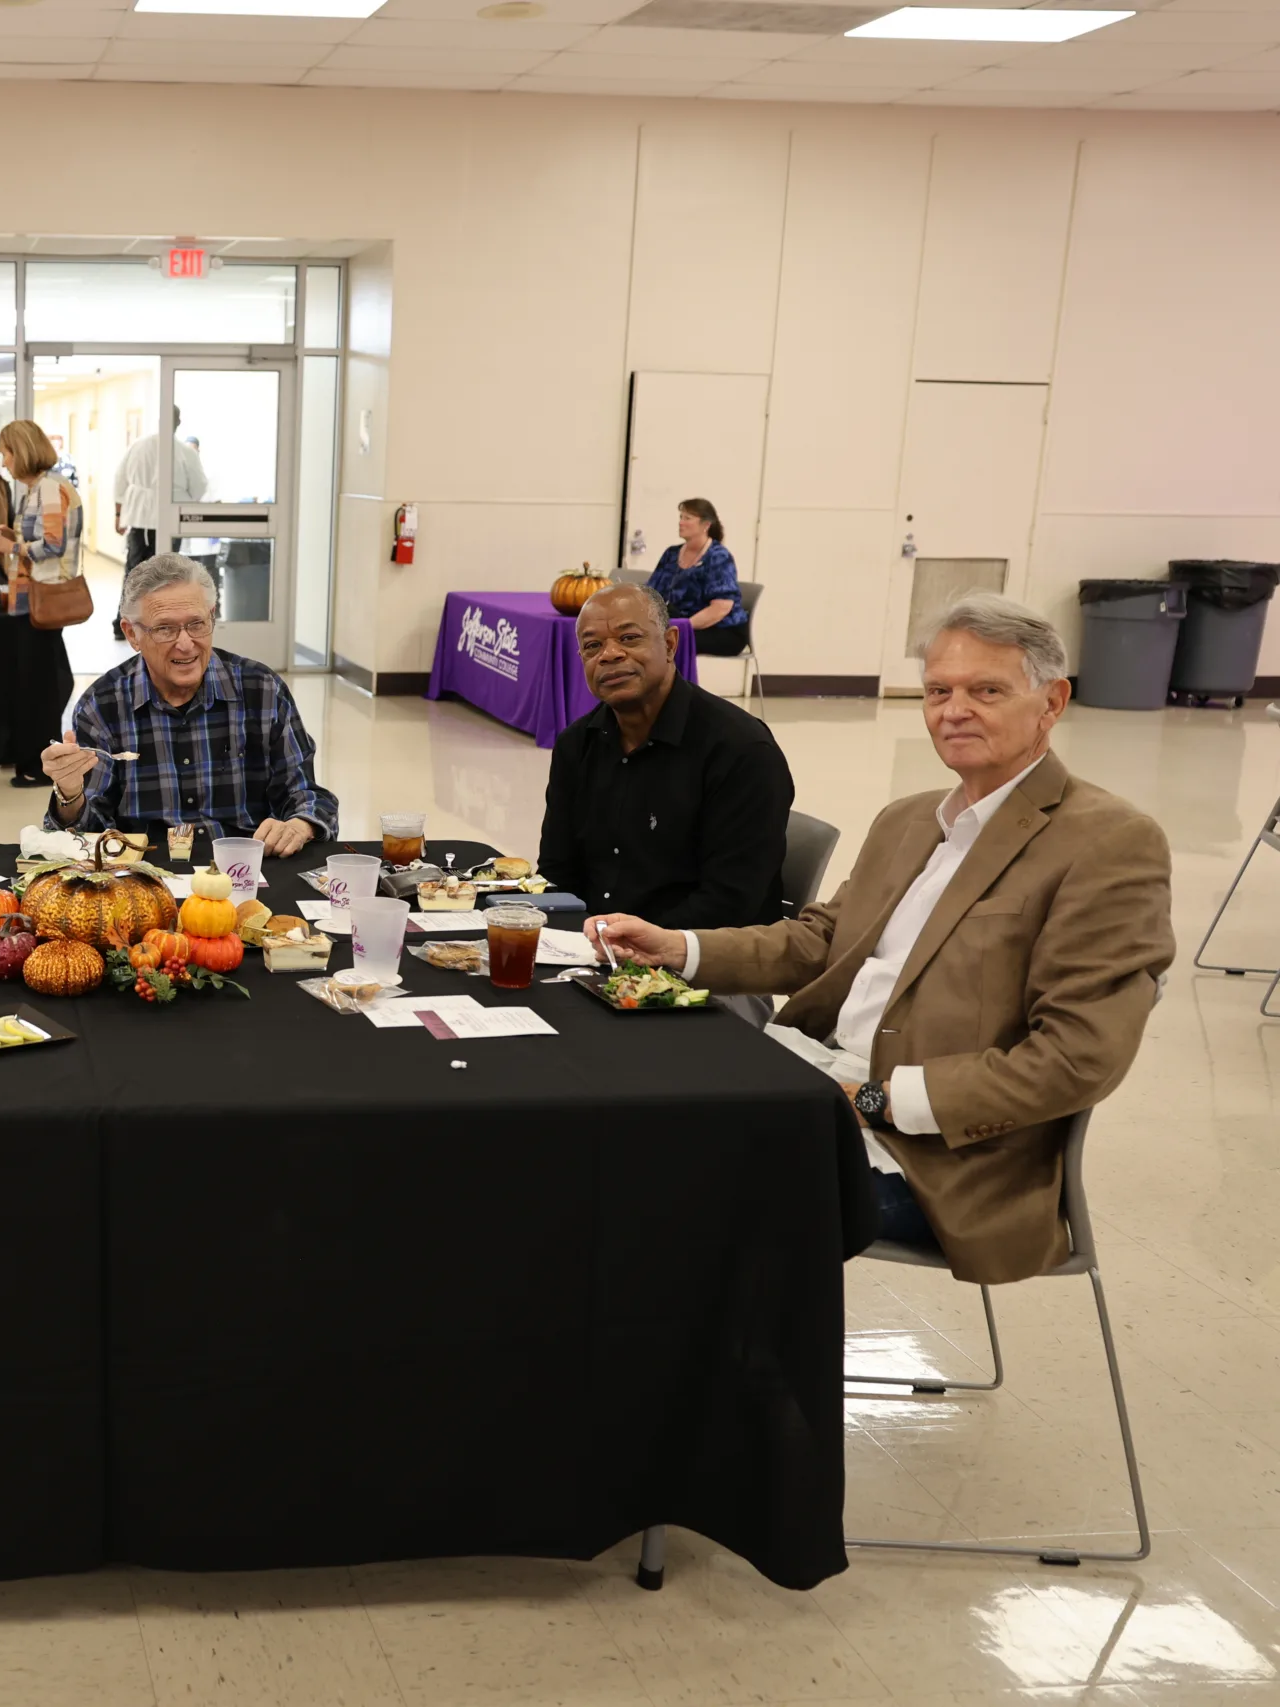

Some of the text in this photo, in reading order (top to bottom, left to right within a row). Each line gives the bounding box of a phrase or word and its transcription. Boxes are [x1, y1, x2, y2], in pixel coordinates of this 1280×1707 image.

[169, 249, 205, 278] EXIT
[457, 605, 520, 658] Jefferson State
[226, 862, 251, 879] 60
